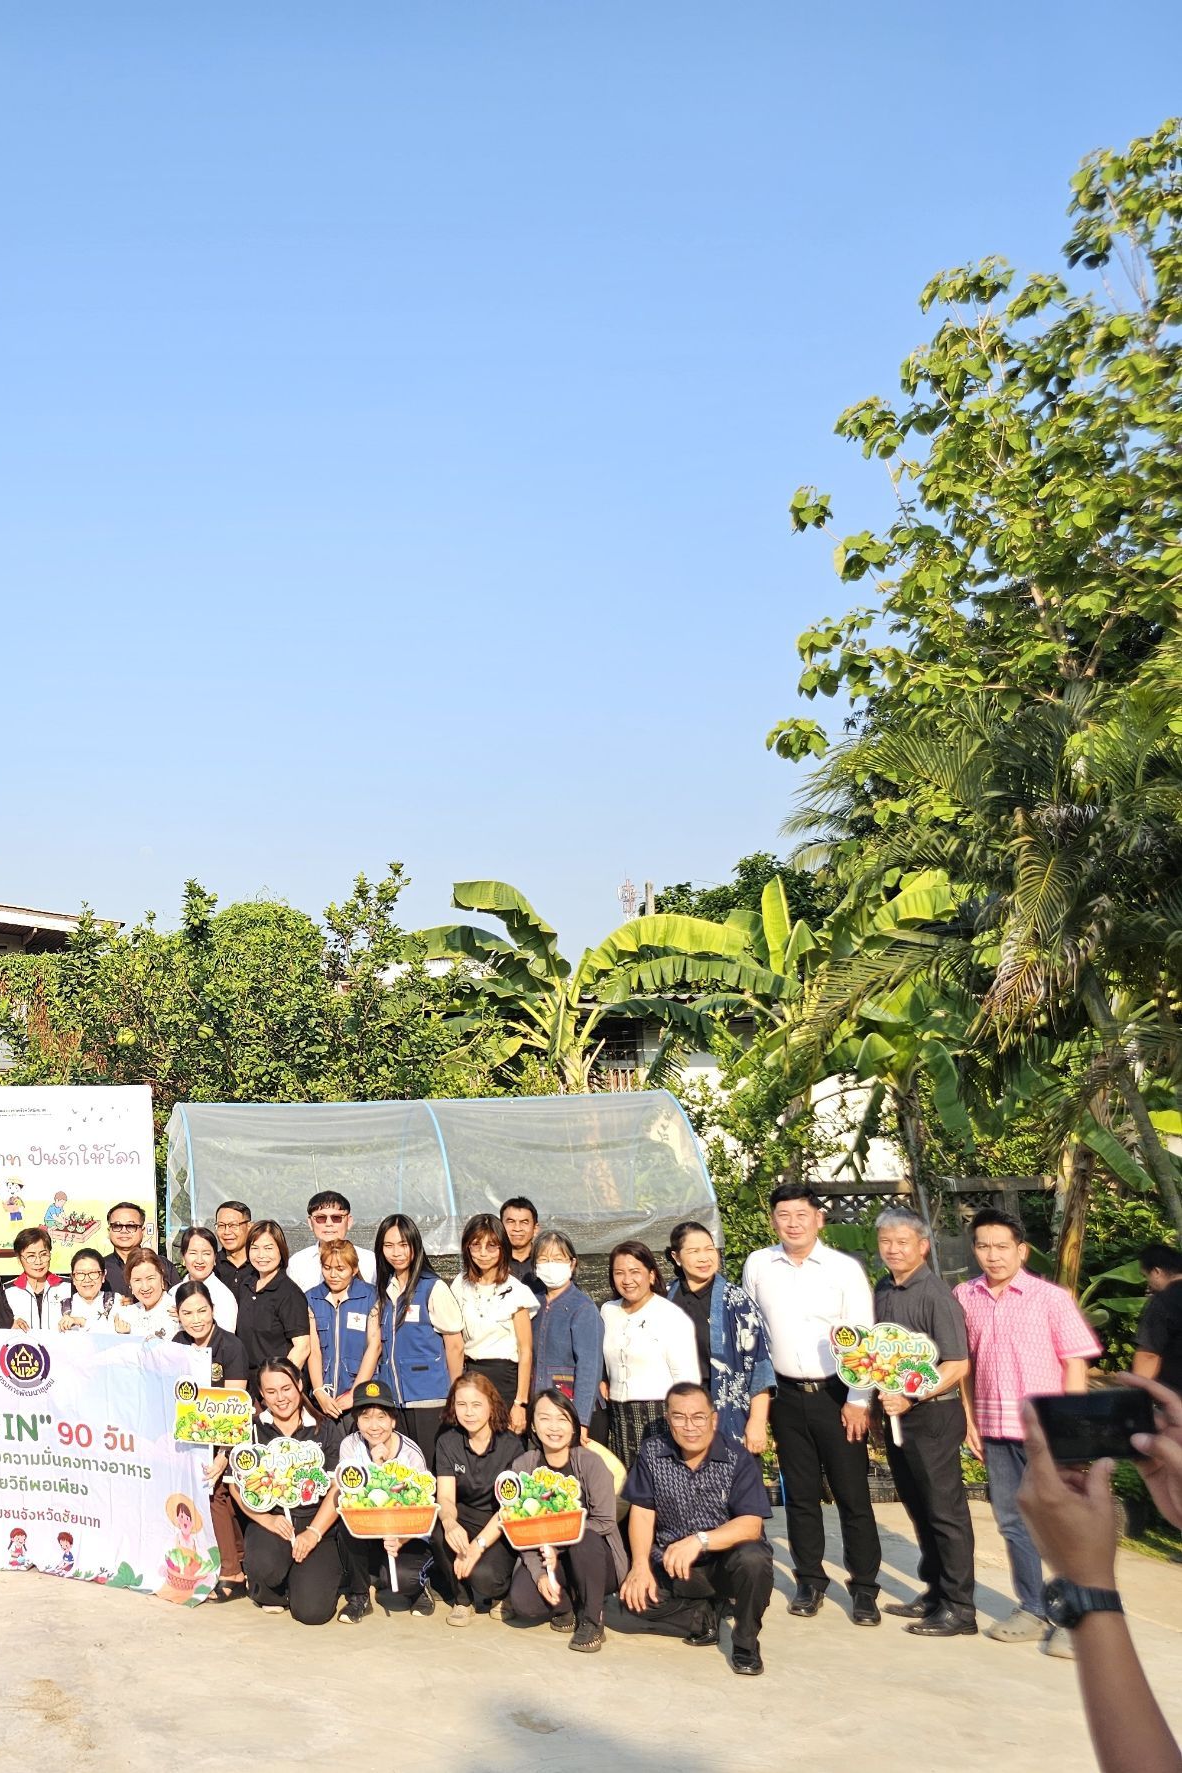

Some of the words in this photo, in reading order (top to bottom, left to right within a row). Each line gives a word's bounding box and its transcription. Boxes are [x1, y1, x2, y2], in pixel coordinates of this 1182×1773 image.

[27, 1143, 141, 1166] ปันรักให้โลก
[863, 1335, 932, 1360] ปลูกผัก
[195, 1397, 248, 1420] ปลูกพืช
[57, 1421, 93, 1448] 90
[103, 1424, 135, 1453] วัน
